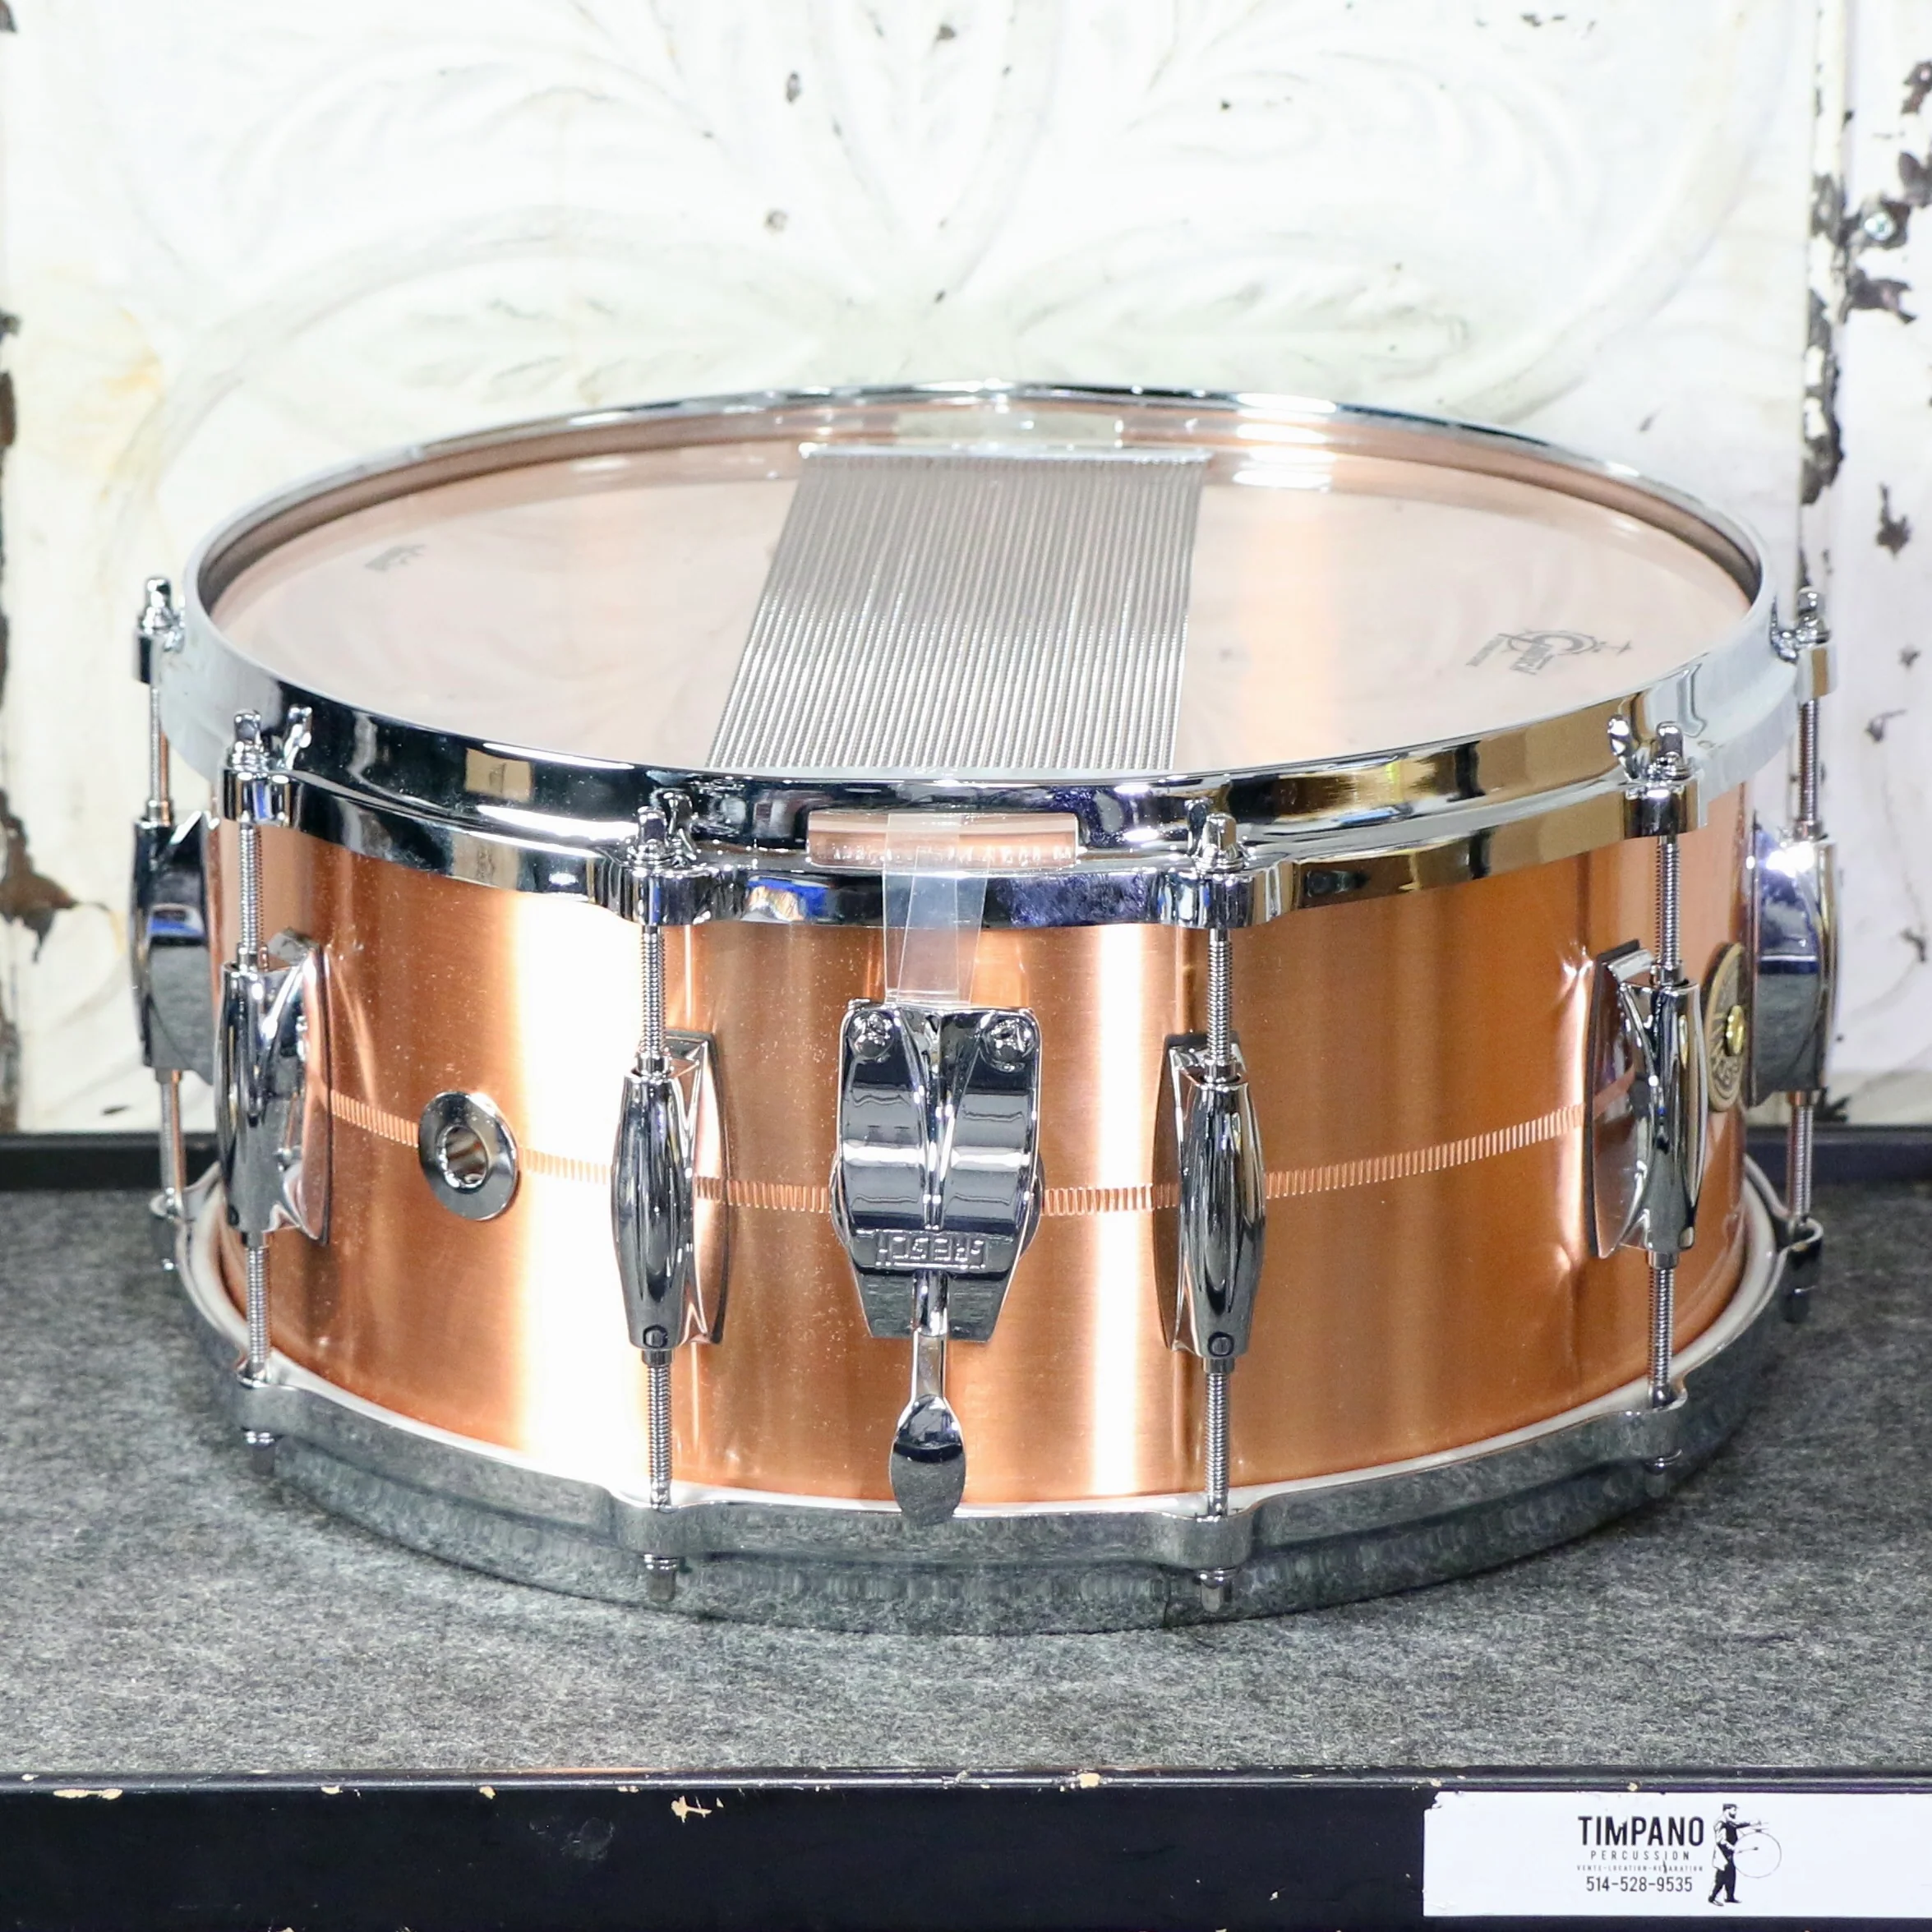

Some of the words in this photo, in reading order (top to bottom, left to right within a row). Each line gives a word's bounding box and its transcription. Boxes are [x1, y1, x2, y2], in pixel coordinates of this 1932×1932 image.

[1578, 1816, 1704, 1847] TIMPANO
[1591, 1851, 1690, 1861] PERCUSSION
[1586, 1876, 1693, 1892] 514-528-9535
